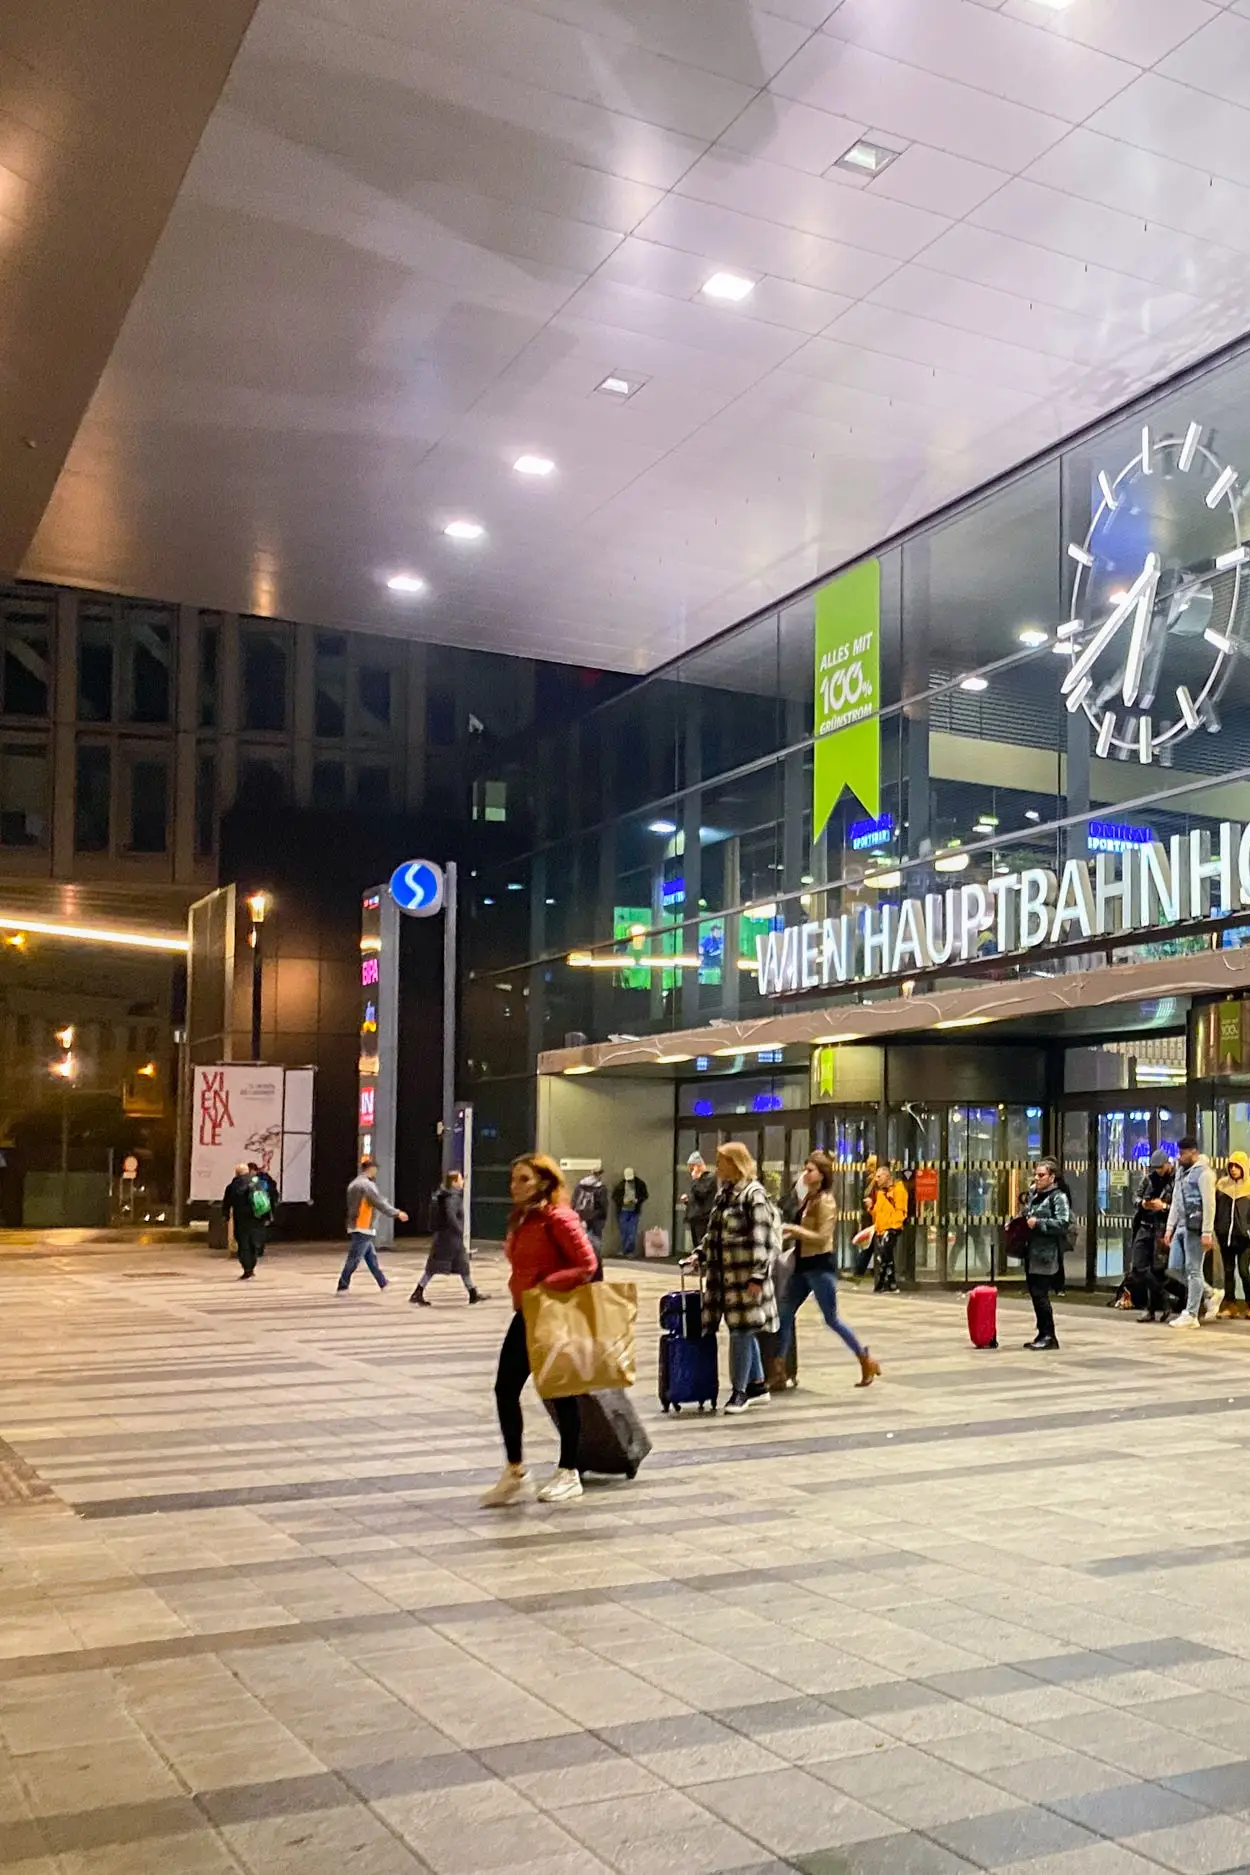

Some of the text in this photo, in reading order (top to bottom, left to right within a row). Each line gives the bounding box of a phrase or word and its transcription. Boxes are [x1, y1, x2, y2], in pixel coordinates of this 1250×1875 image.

[820, 631, 873, 672] ALLES MIT
[820, 660, 873, 714] 100%
[756, 915, 850, 996] WIEN
